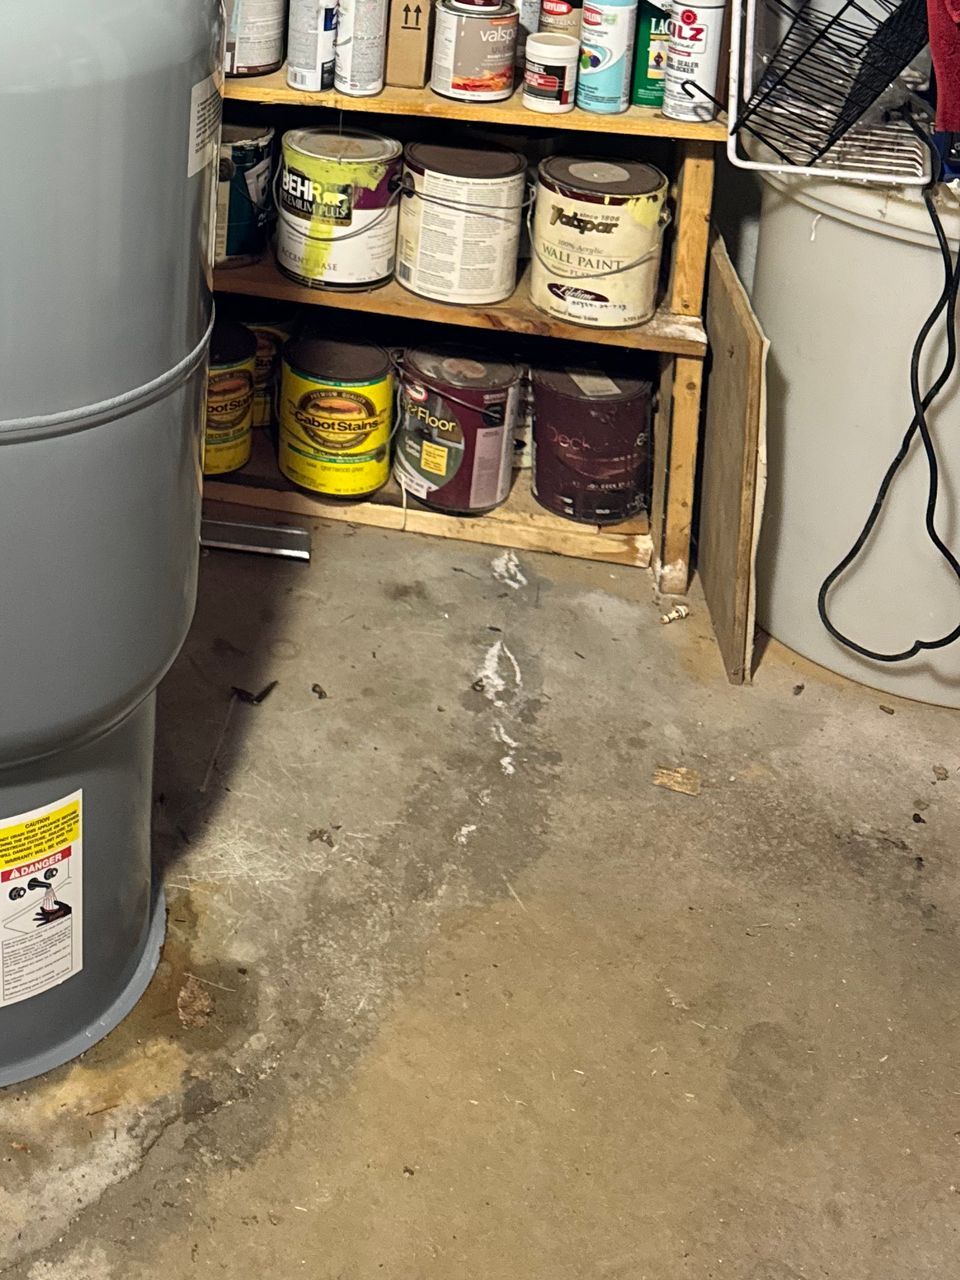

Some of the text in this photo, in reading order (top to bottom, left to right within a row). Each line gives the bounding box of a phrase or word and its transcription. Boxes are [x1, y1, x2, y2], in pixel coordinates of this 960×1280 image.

[543, 0, 568, 14] KRYLON
[670, 22, 705, 42] ILZ
[677, 59, 699, 69] SEALER
[282, 171, 323, 204] BEHR
[319, 205, 346, 218] PLUS
[550, 204, 620, 235] Valspar
[580, 212, 599, 220] since
[542, 242, 624, 271] WALL PAINT
[558, 239, 605, 256] 100% Acrylic
[559, 284, 596, 301] Lifetime
[417, 407, 457, 432] Floor
[10, 832, 26, 840] DRAIN
[38, 819, 61, 831] APPLIANCE
[61, 810, 77, 820] BEFORE
[23, 833, 39, 841] RELIEF
[39, 828, 53, 836] VALVE
[60, 813, 79, 826] ANOTHER
[25, 815, 51, 829] CAUTION
[4, 851, 33, 864] WARRANTY
[34, 847, 47, 855] WILL
[12, 846, 33, 856] DAMAGE
[44, 837, 55, 845] UNIT
[21, 852, 63, 876] DANGER
